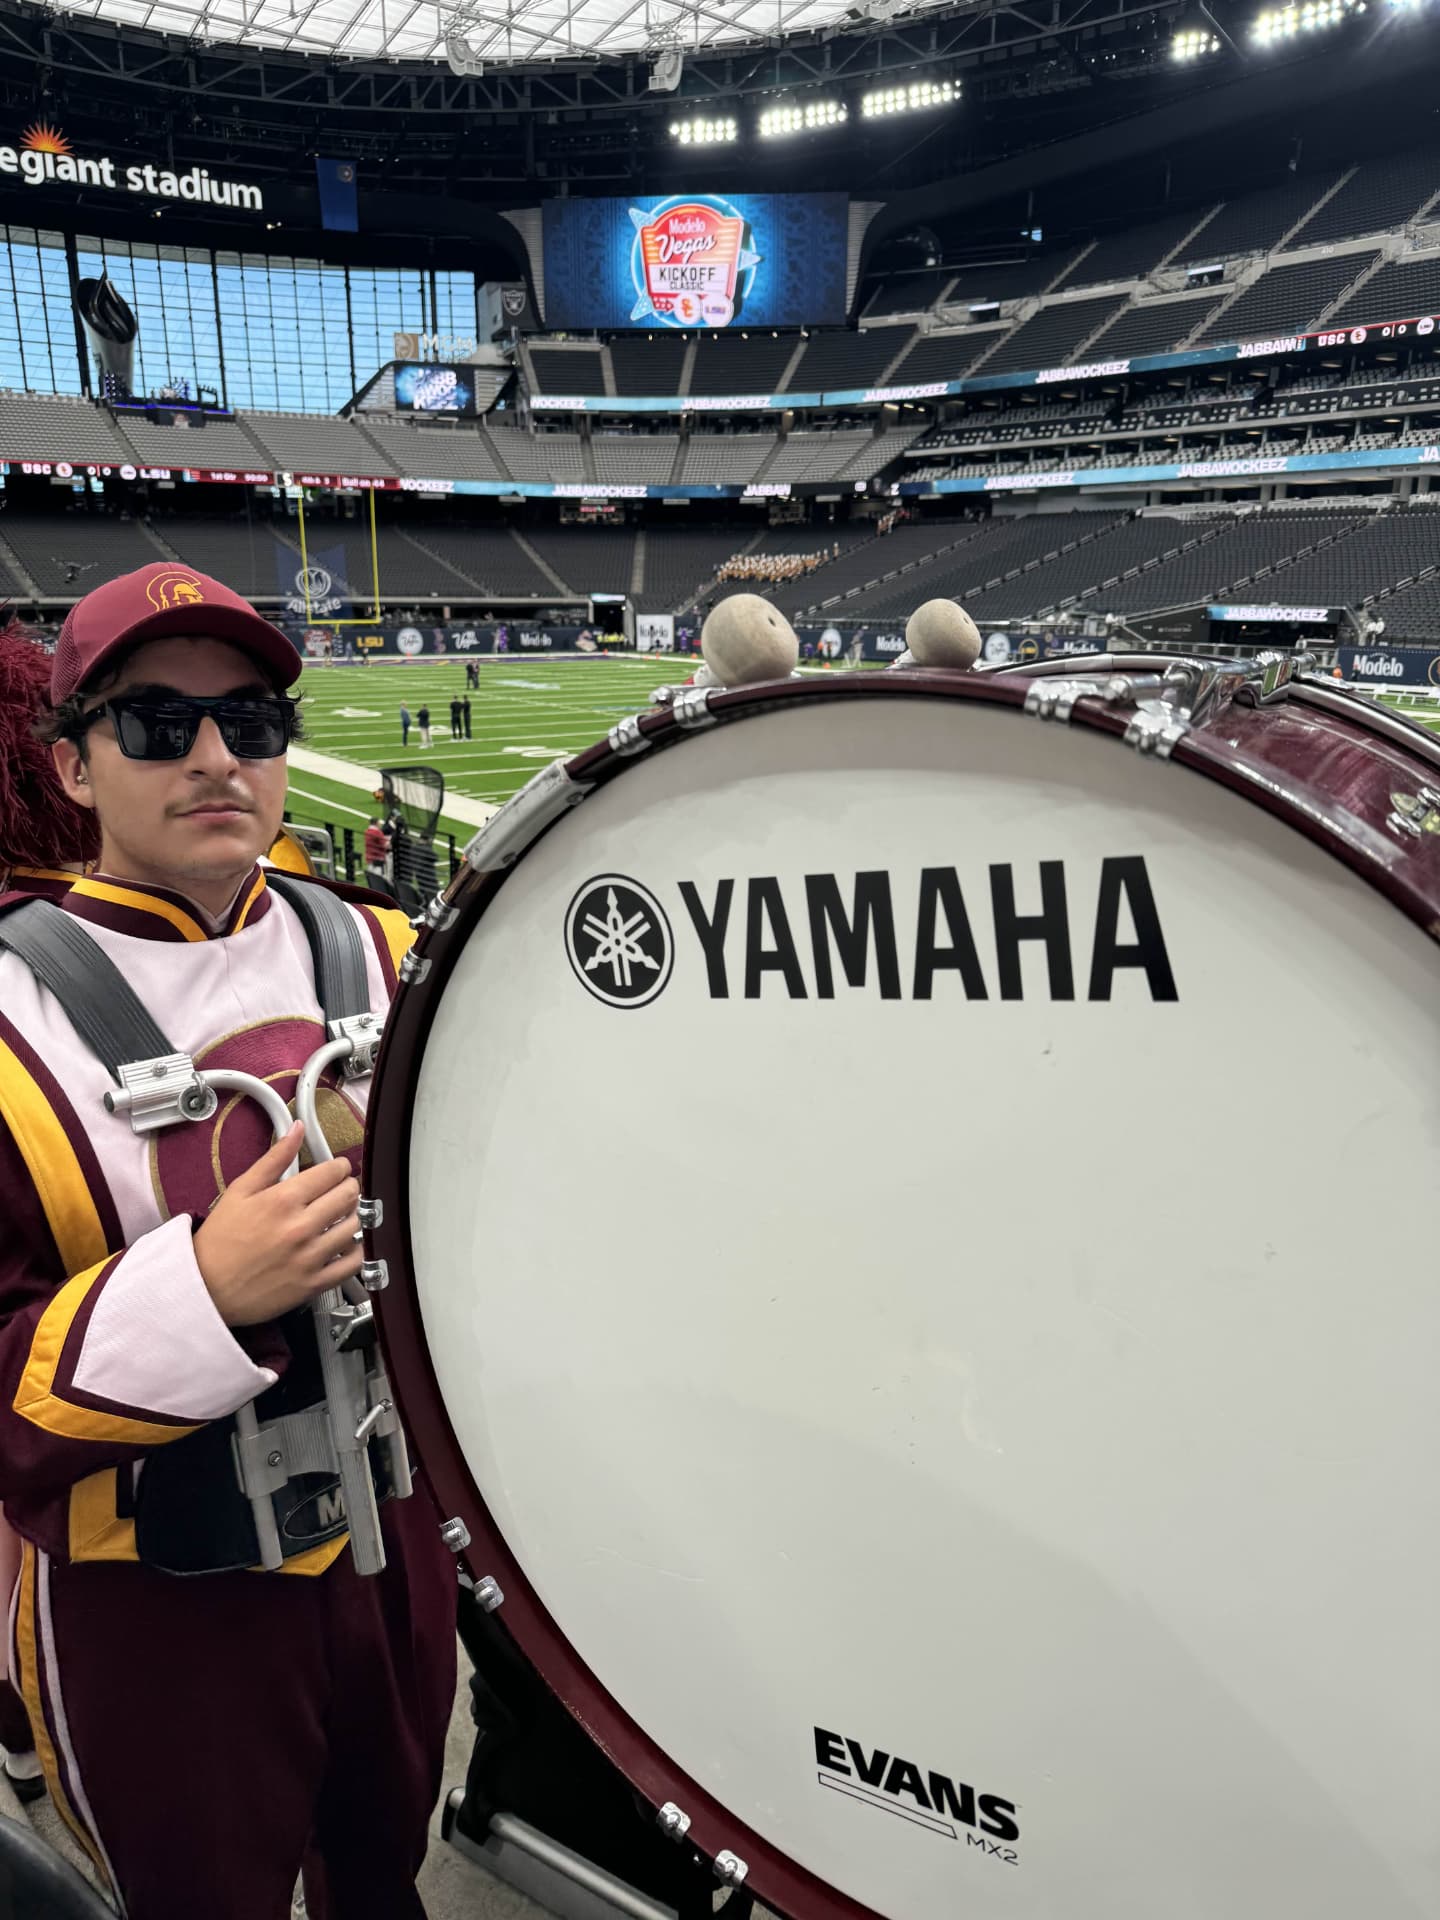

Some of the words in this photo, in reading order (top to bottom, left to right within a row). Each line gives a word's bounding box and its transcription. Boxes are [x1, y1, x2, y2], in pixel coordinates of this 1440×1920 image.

[126, 165, 263, 210] stadium
[669, 218, 705, 234] Modelo
[655, 234, 716, 264] Vegas
[659, 267, 716, 281] KICKOFF
[669, 281, 704, 290] CLASSIC
[422, 334, 473, 352] MGM
[1318, 333, 1346, 347] USC
[1035, 360, 1130, 384] JABBAWOCKEEZ
[22, 463, 51, 475] USC
[140, 468, 171, 480] LSU
[1177, 458, 1288, 479] JABBAWOCKEEZ
[984, 473, 1074, 491] JABBAWOCKEEZ
[552, 485, 647, 498] JABBAWOCKEEZ
[286, 599, 342, 615] Allstate
[1223, 607, 1328, 622] JABBAWOCKEEZ
[356, 636, 384, 648] LSU
[876, 635, 906, 651] Modelo
[1353, 654, 1404, 677] Modelo
[677, 855, 1180, 1003] YAMAHA
[814, 1726, 1020, 1841] EVANS
[966, 1831, 1019, 1866] MX2
